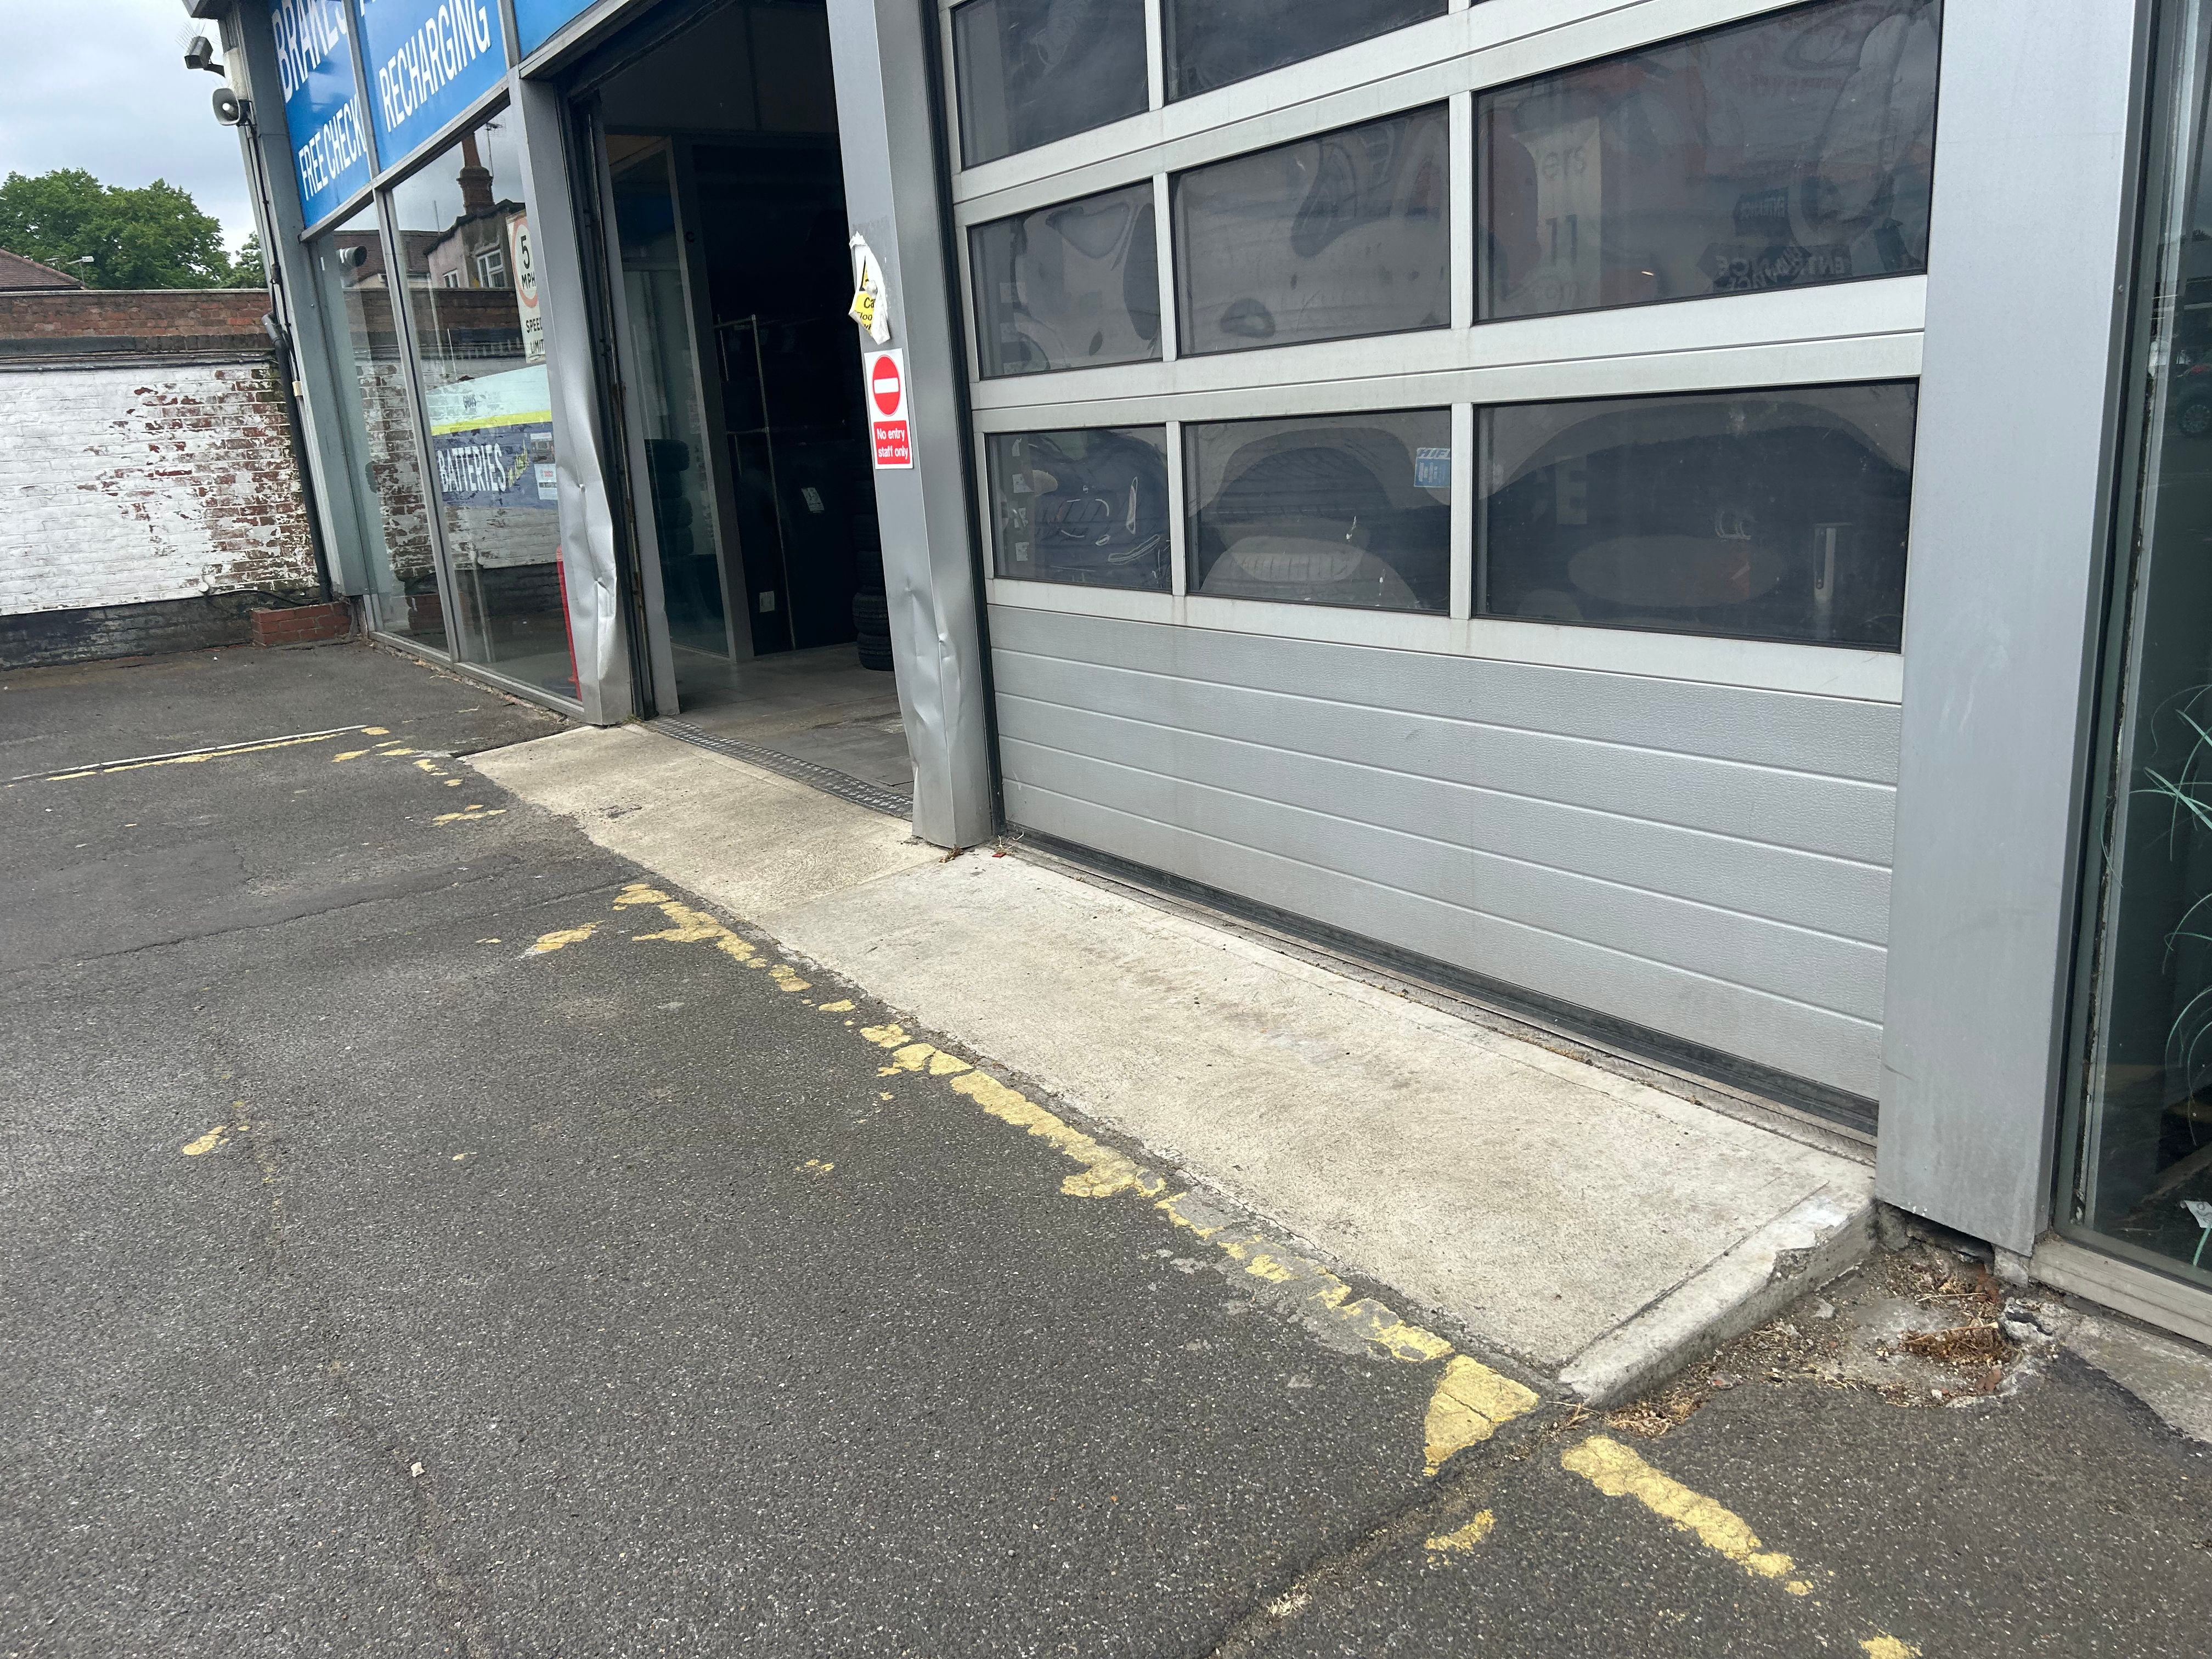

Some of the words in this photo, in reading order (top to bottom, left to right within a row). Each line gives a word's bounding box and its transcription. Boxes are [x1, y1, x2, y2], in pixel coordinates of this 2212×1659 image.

[379, 0, 490, 132] RECHARGING
[298, 132, 329, 201] FREE
[520, 235, 531, 269] 5
[521, 271, 536, 290] MPH
[864, 297, 876, 308] Ca
[530, 339, 545, 354] LIMIT
[877, 428, 887, 439] No
[888, 429, 905, 442] entry
[878, 445, 893, 458] staff
[894, 445, 909, 460] only
[437, 443, 506, 492] BATTERIES
